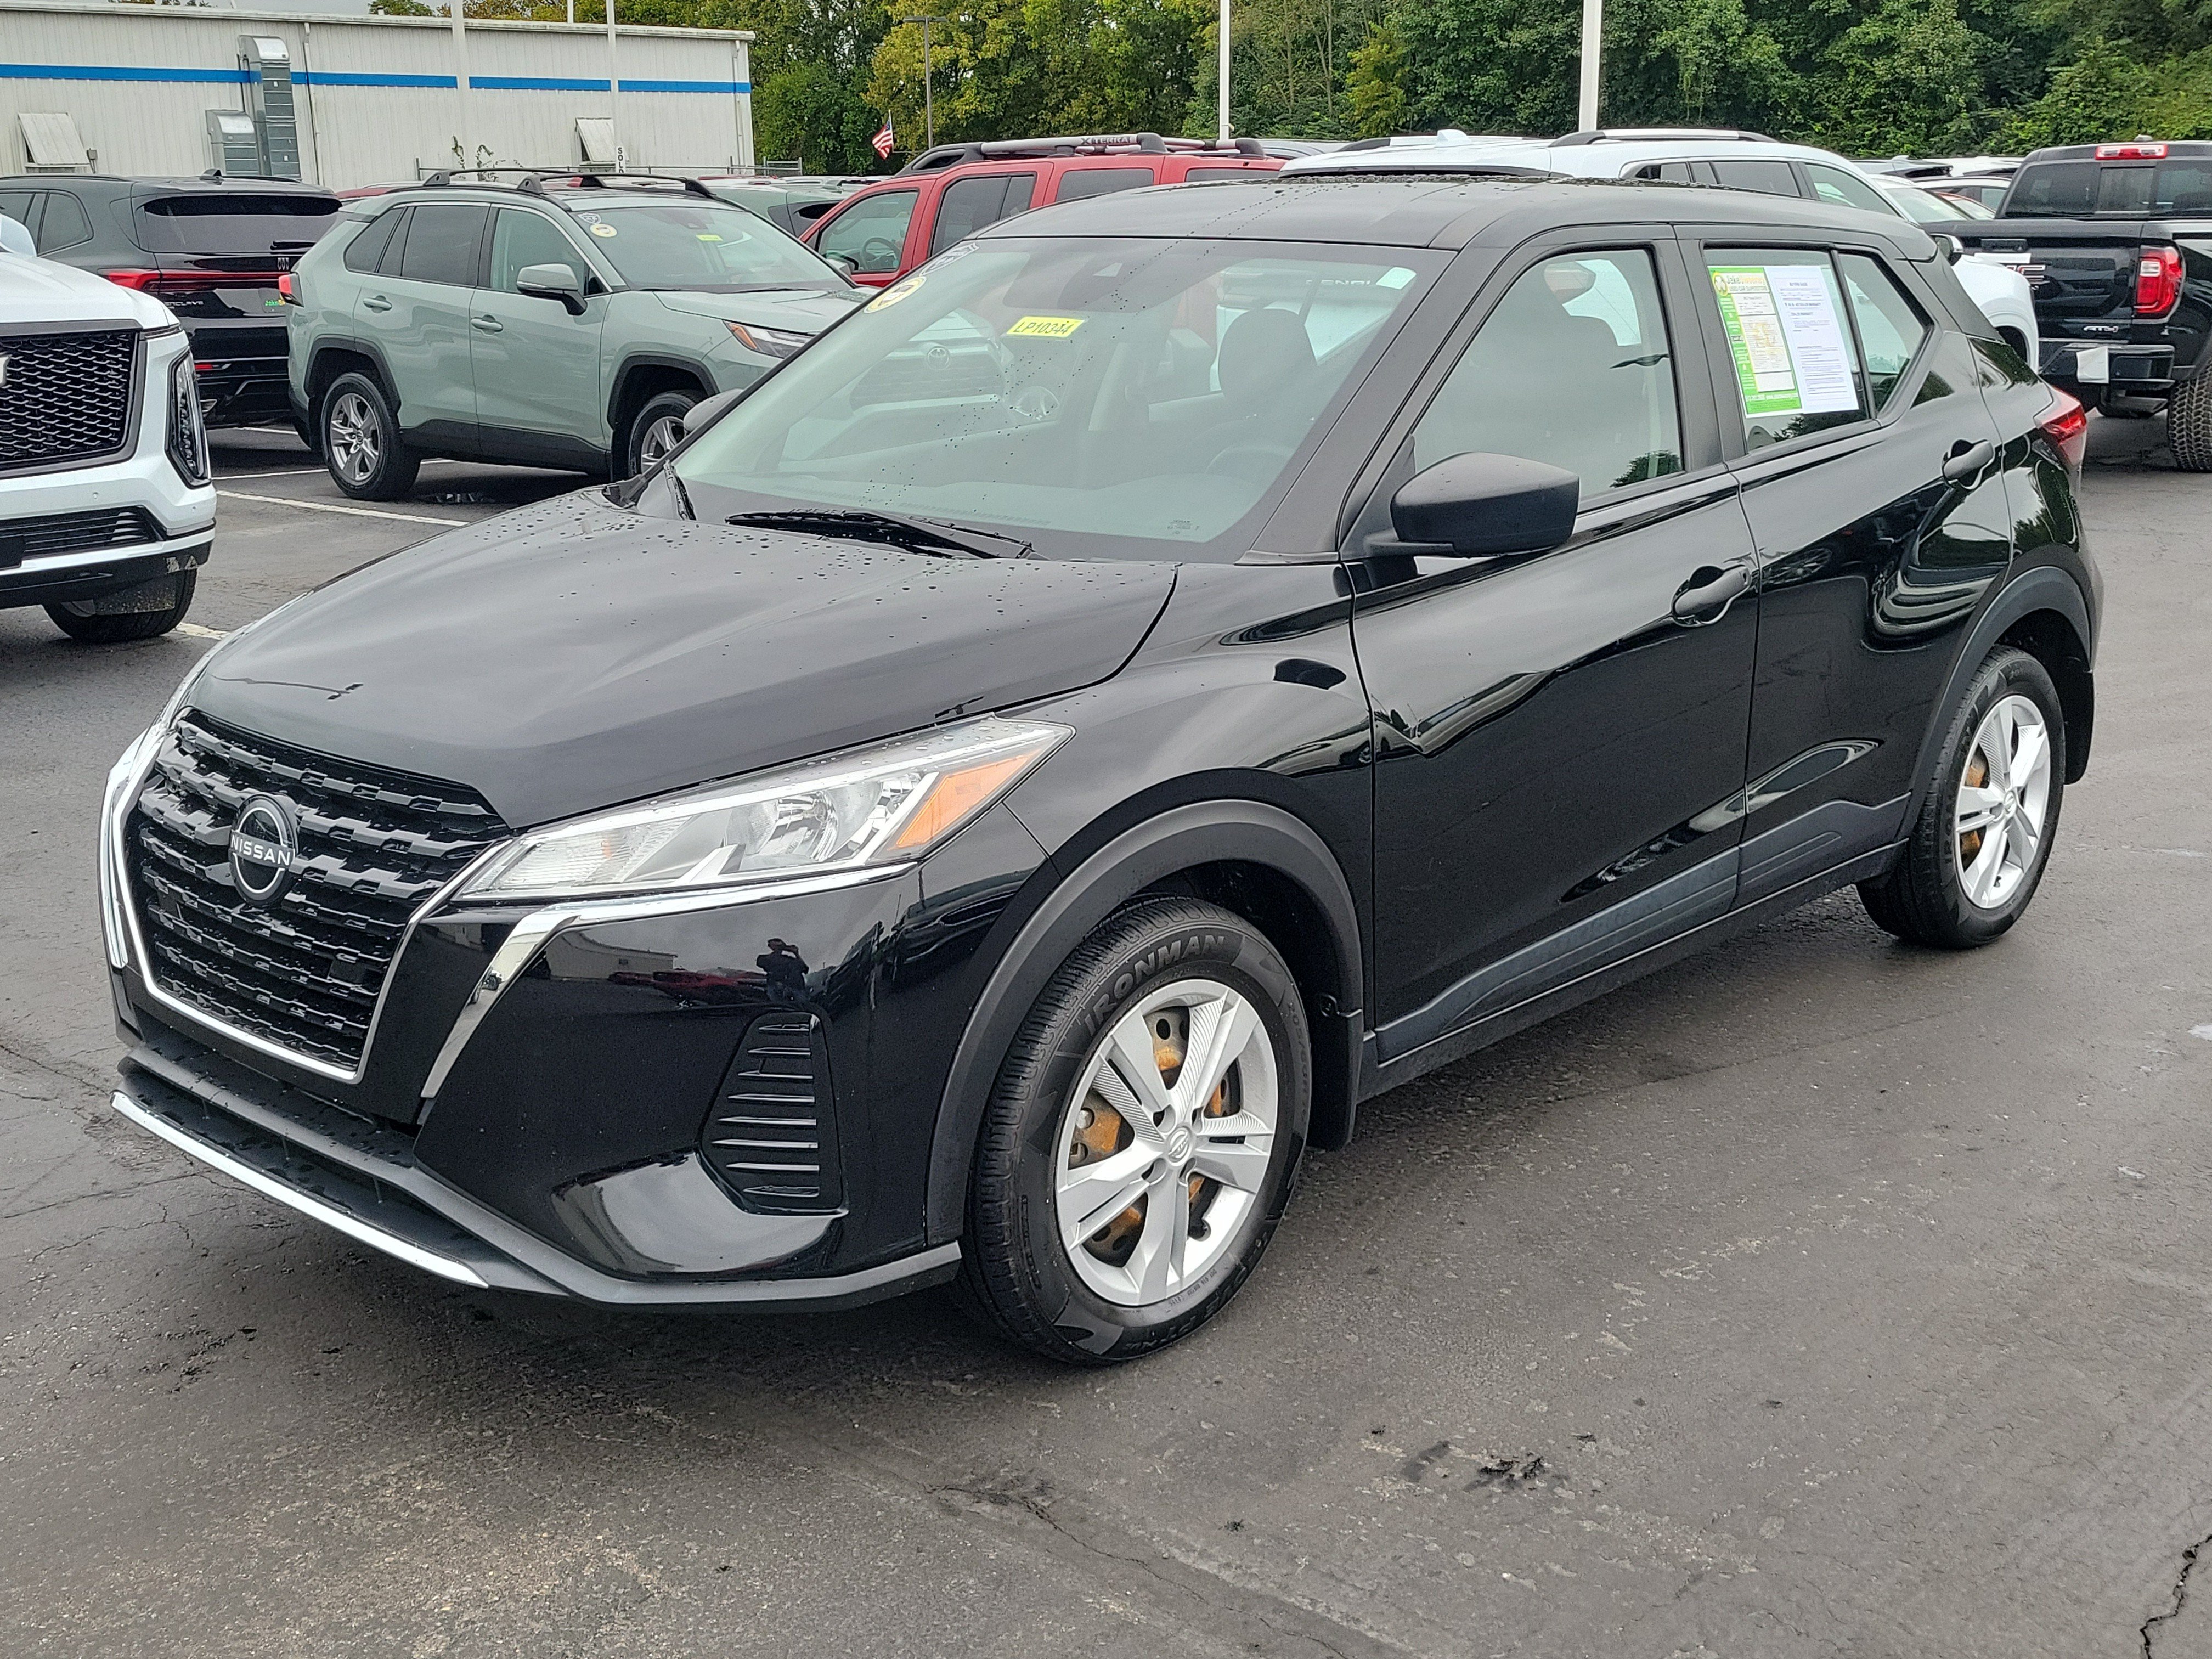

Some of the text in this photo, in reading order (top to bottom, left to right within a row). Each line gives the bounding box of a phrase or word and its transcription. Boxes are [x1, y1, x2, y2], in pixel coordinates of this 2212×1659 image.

[1081, 134, 1130, 145] XTERRA
[231, 834, 291, 866] NISSAN
[1084, 935, 1224, 1037] IRONMAN
